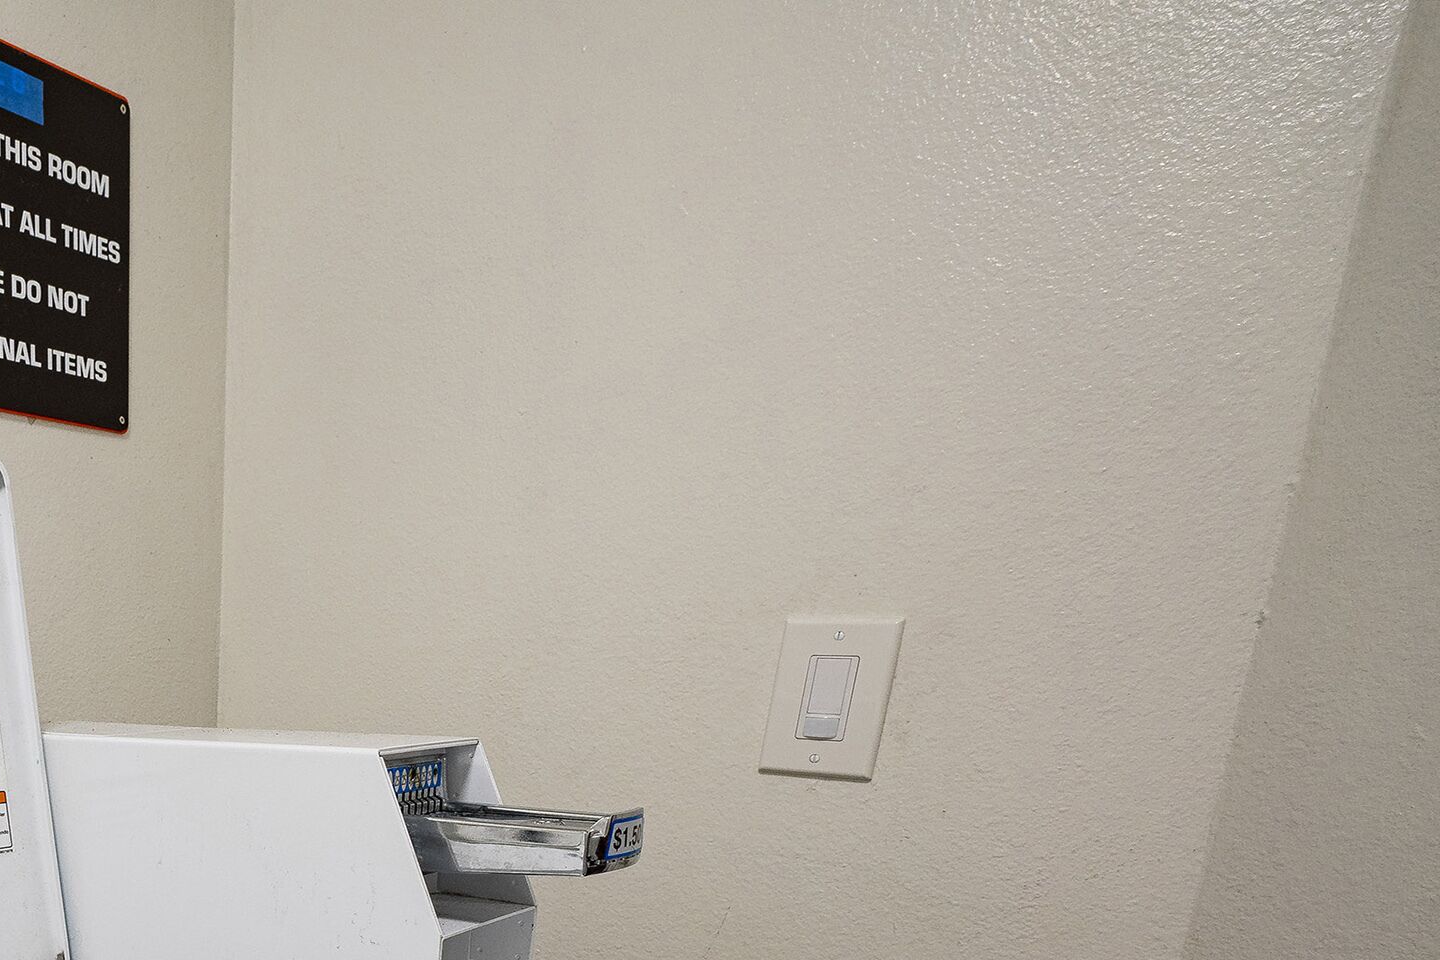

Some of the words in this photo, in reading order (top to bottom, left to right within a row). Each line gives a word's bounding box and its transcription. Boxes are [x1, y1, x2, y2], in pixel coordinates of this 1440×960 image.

[48, 154, 110, 198] ROOM
[20, 210, 57, 244] ALL
[62, 224, 121, 264] TIMES
[11, 274, 42, 304] DO
[48, 286, 89, 317] NOT
[47, 348, 108, 383] ITEMS
